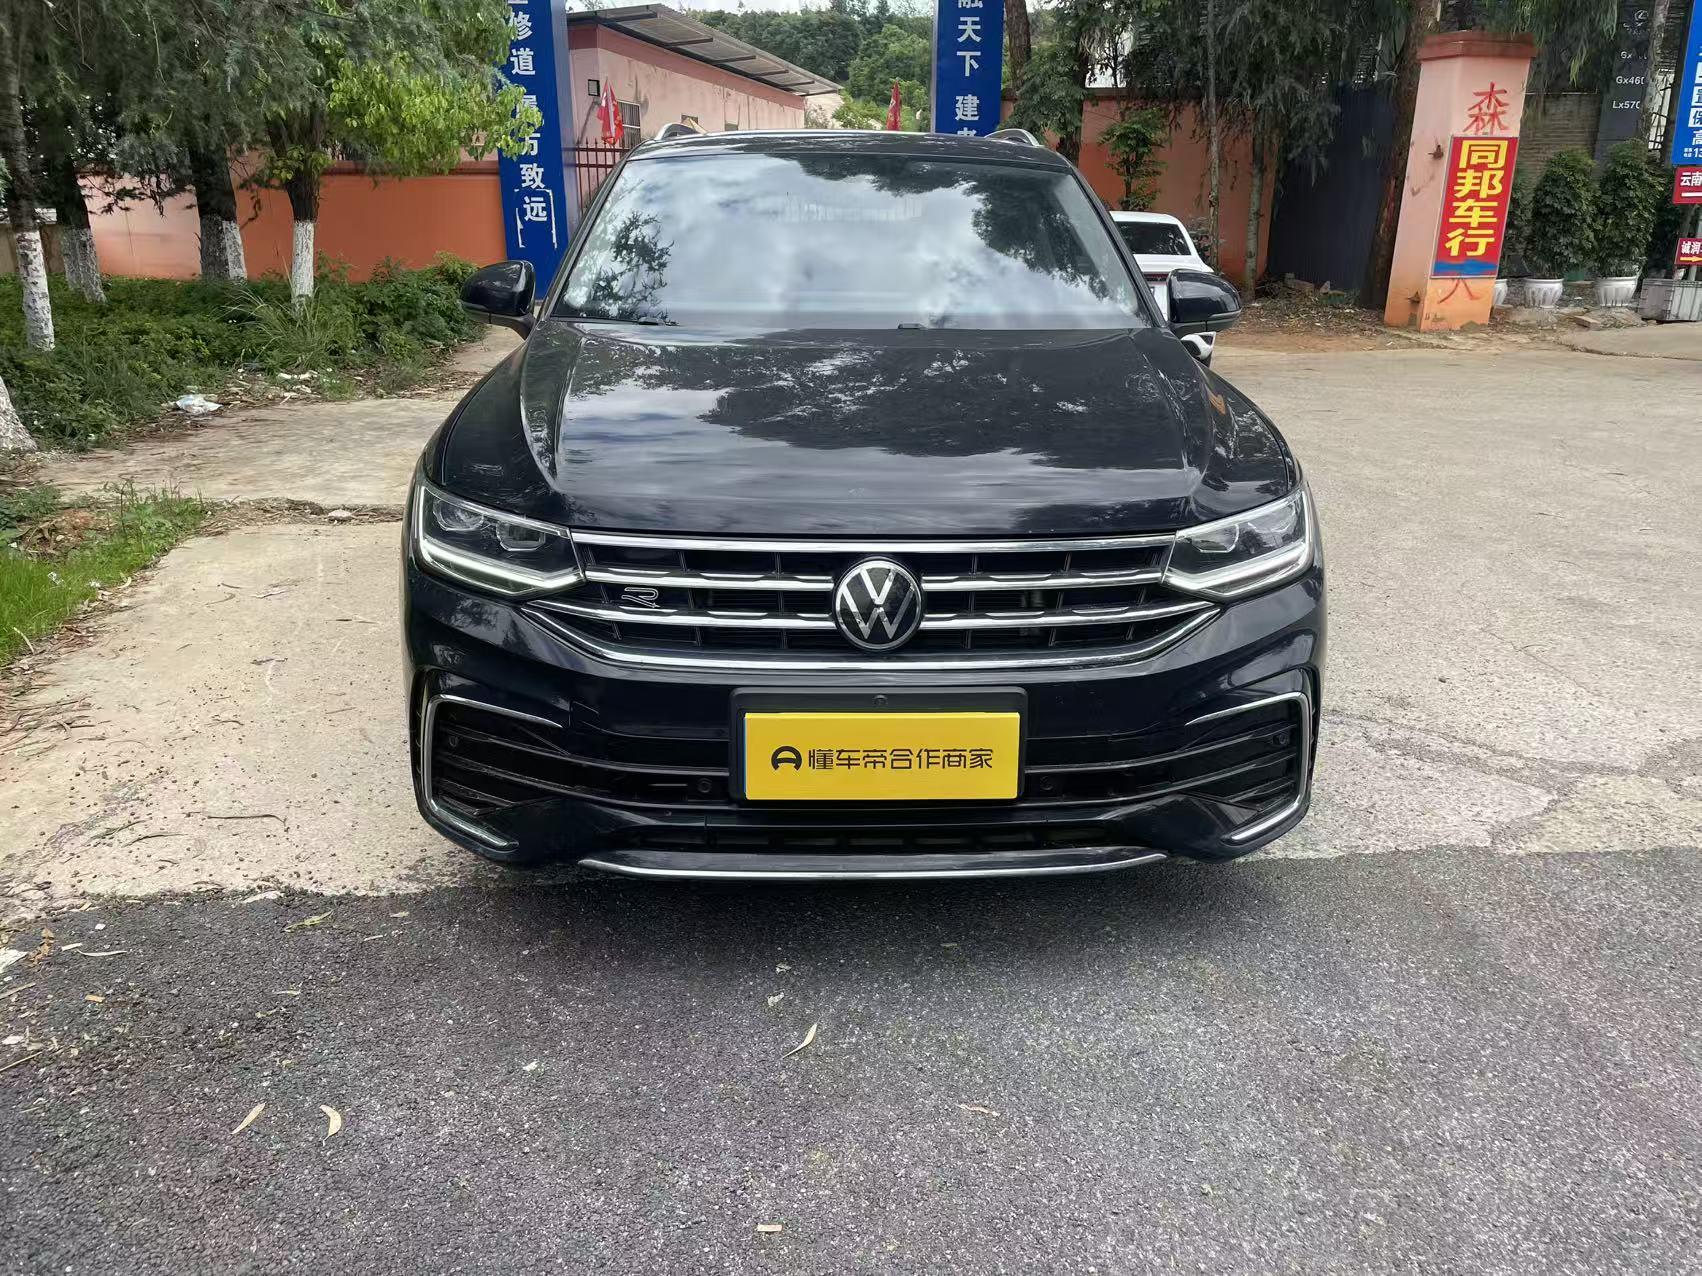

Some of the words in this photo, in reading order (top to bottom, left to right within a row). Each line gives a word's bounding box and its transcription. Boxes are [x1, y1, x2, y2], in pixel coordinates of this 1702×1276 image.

[508, 0, 536, 76] 修道
[1463, 81, 1509, 135] 森
[1444, 140, 1509, 257] 同邦车行
[808, 748, 993, 770] 懂车帝合作商家
